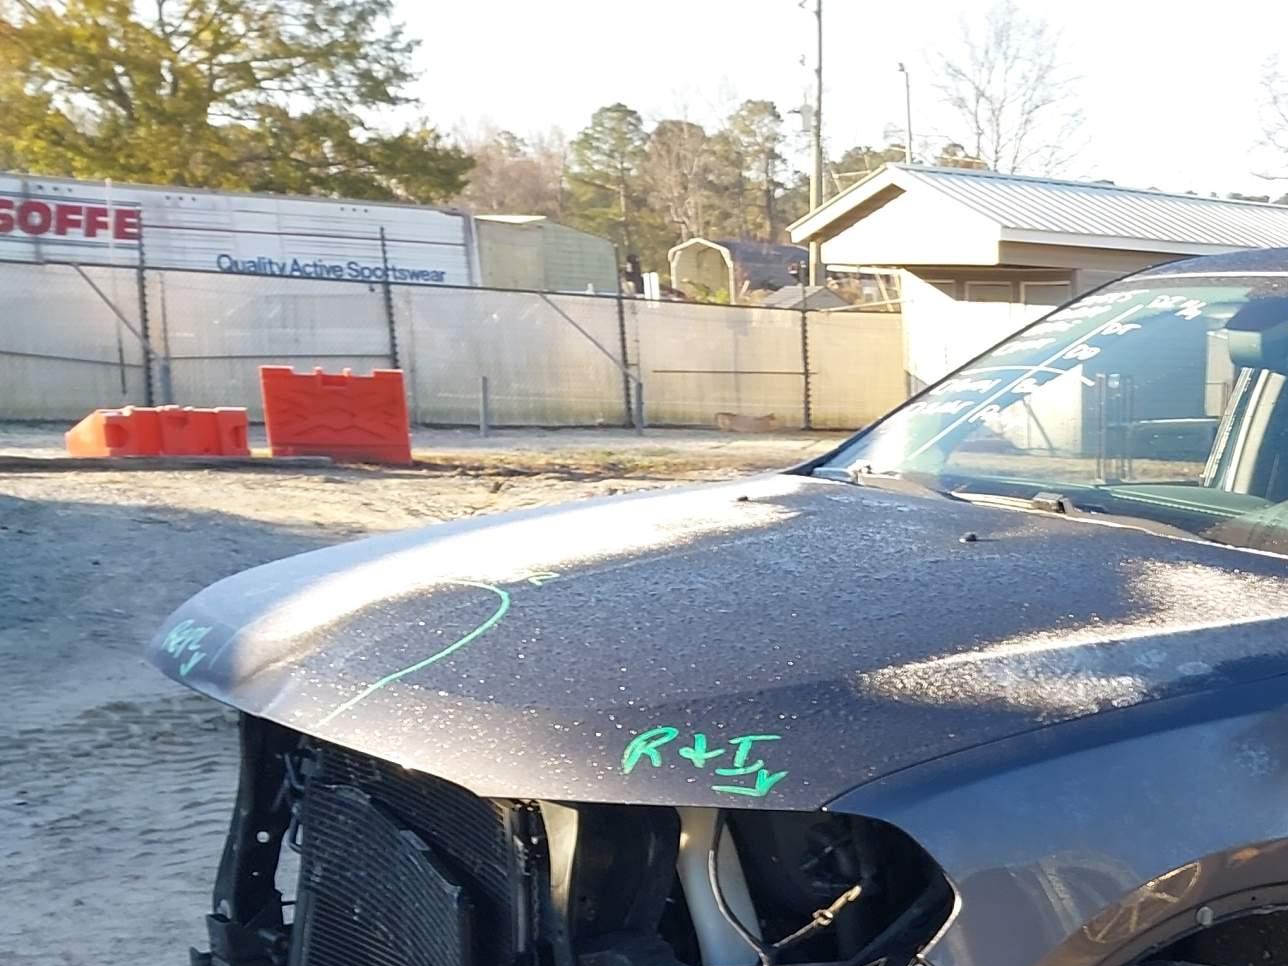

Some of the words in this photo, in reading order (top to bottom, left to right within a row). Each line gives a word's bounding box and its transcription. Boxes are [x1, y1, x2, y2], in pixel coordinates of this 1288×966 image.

[216, 254, 286, 275] Quality
[290, 258, 343, 278] Active
[346, 261, 446, 283] Sportswear
